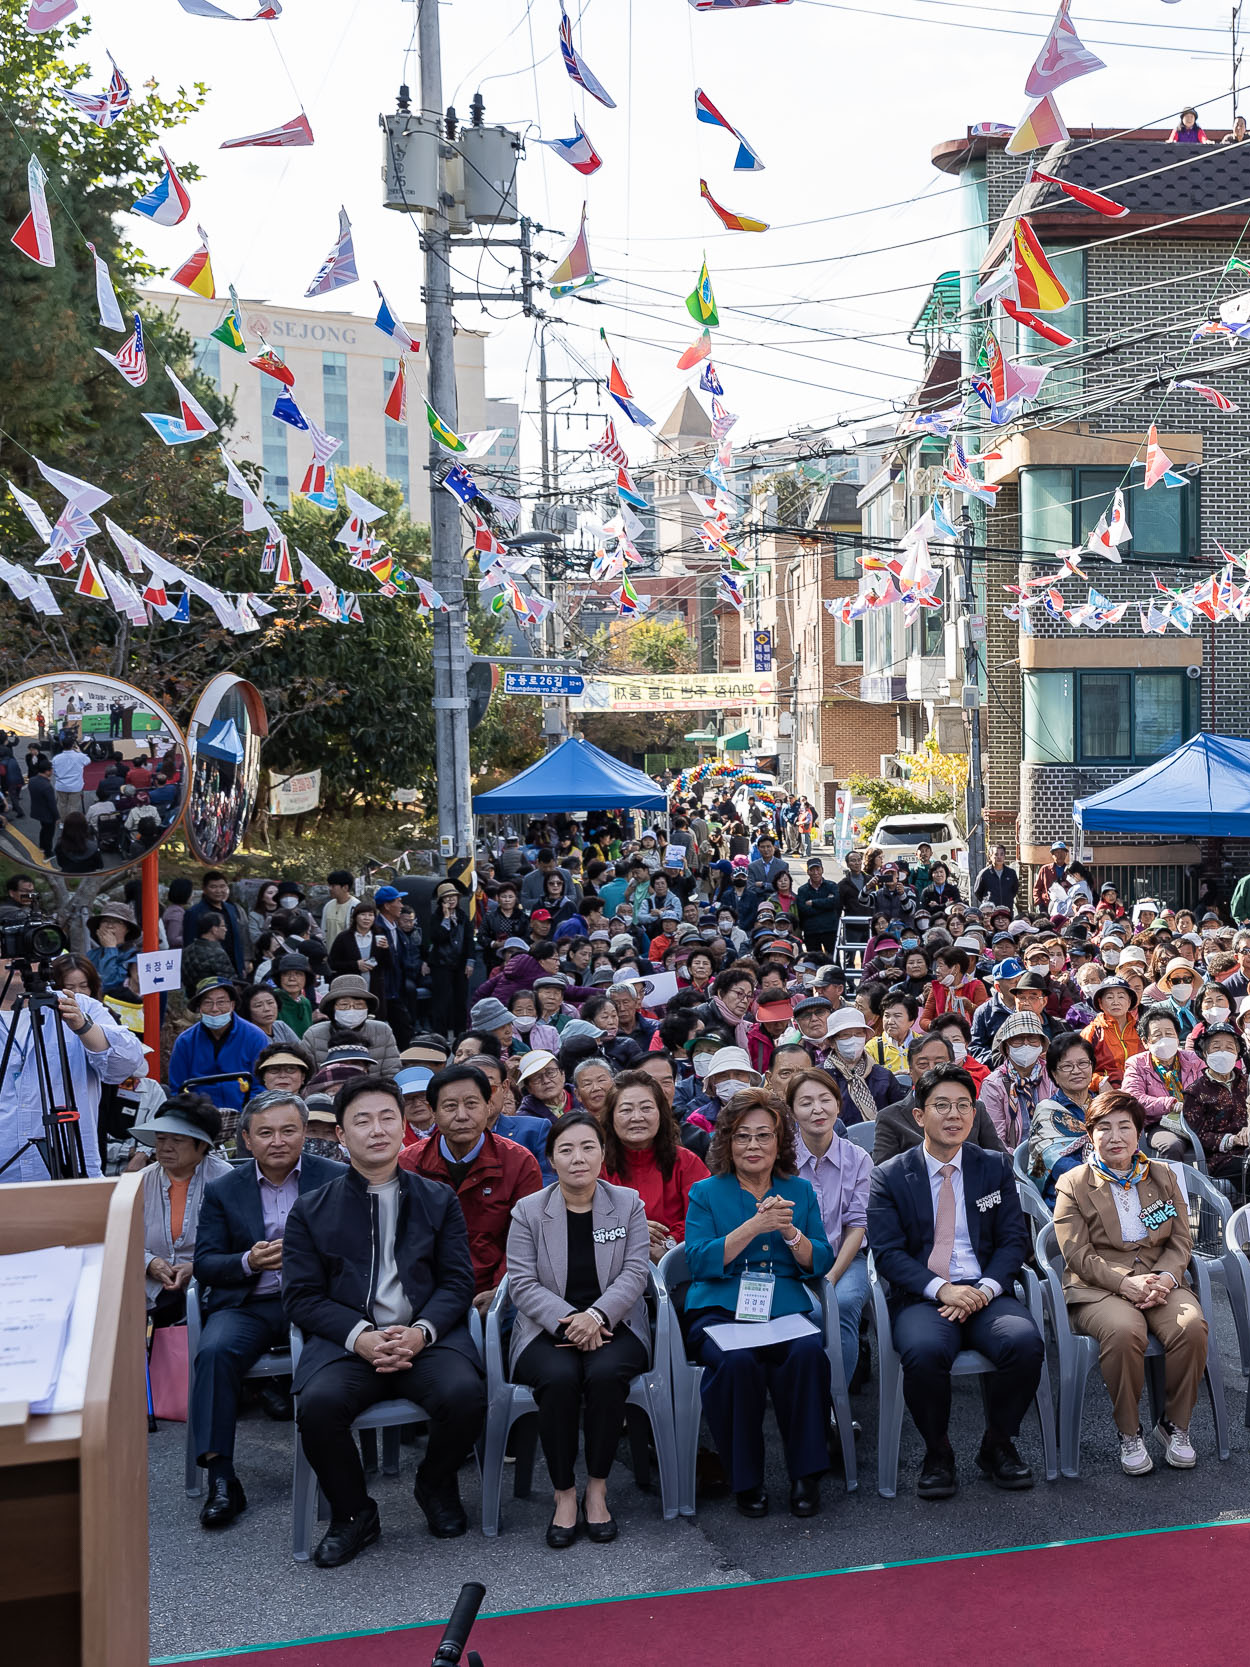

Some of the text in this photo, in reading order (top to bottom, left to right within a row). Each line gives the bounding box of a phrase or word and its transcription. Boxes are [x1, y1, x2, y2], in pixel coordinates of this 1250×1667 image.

[273, 320, 356, 345] SEJONG
[507, 675, 563, 688] 능동로26길
[507, 685, 550, 693] Neungdong-ro
[145, 960, 174, 973] 화장실
[1142, 1200, 1164, 1216] 국회의원
[1142, 1204, 1178, 1230] 전혜숙
